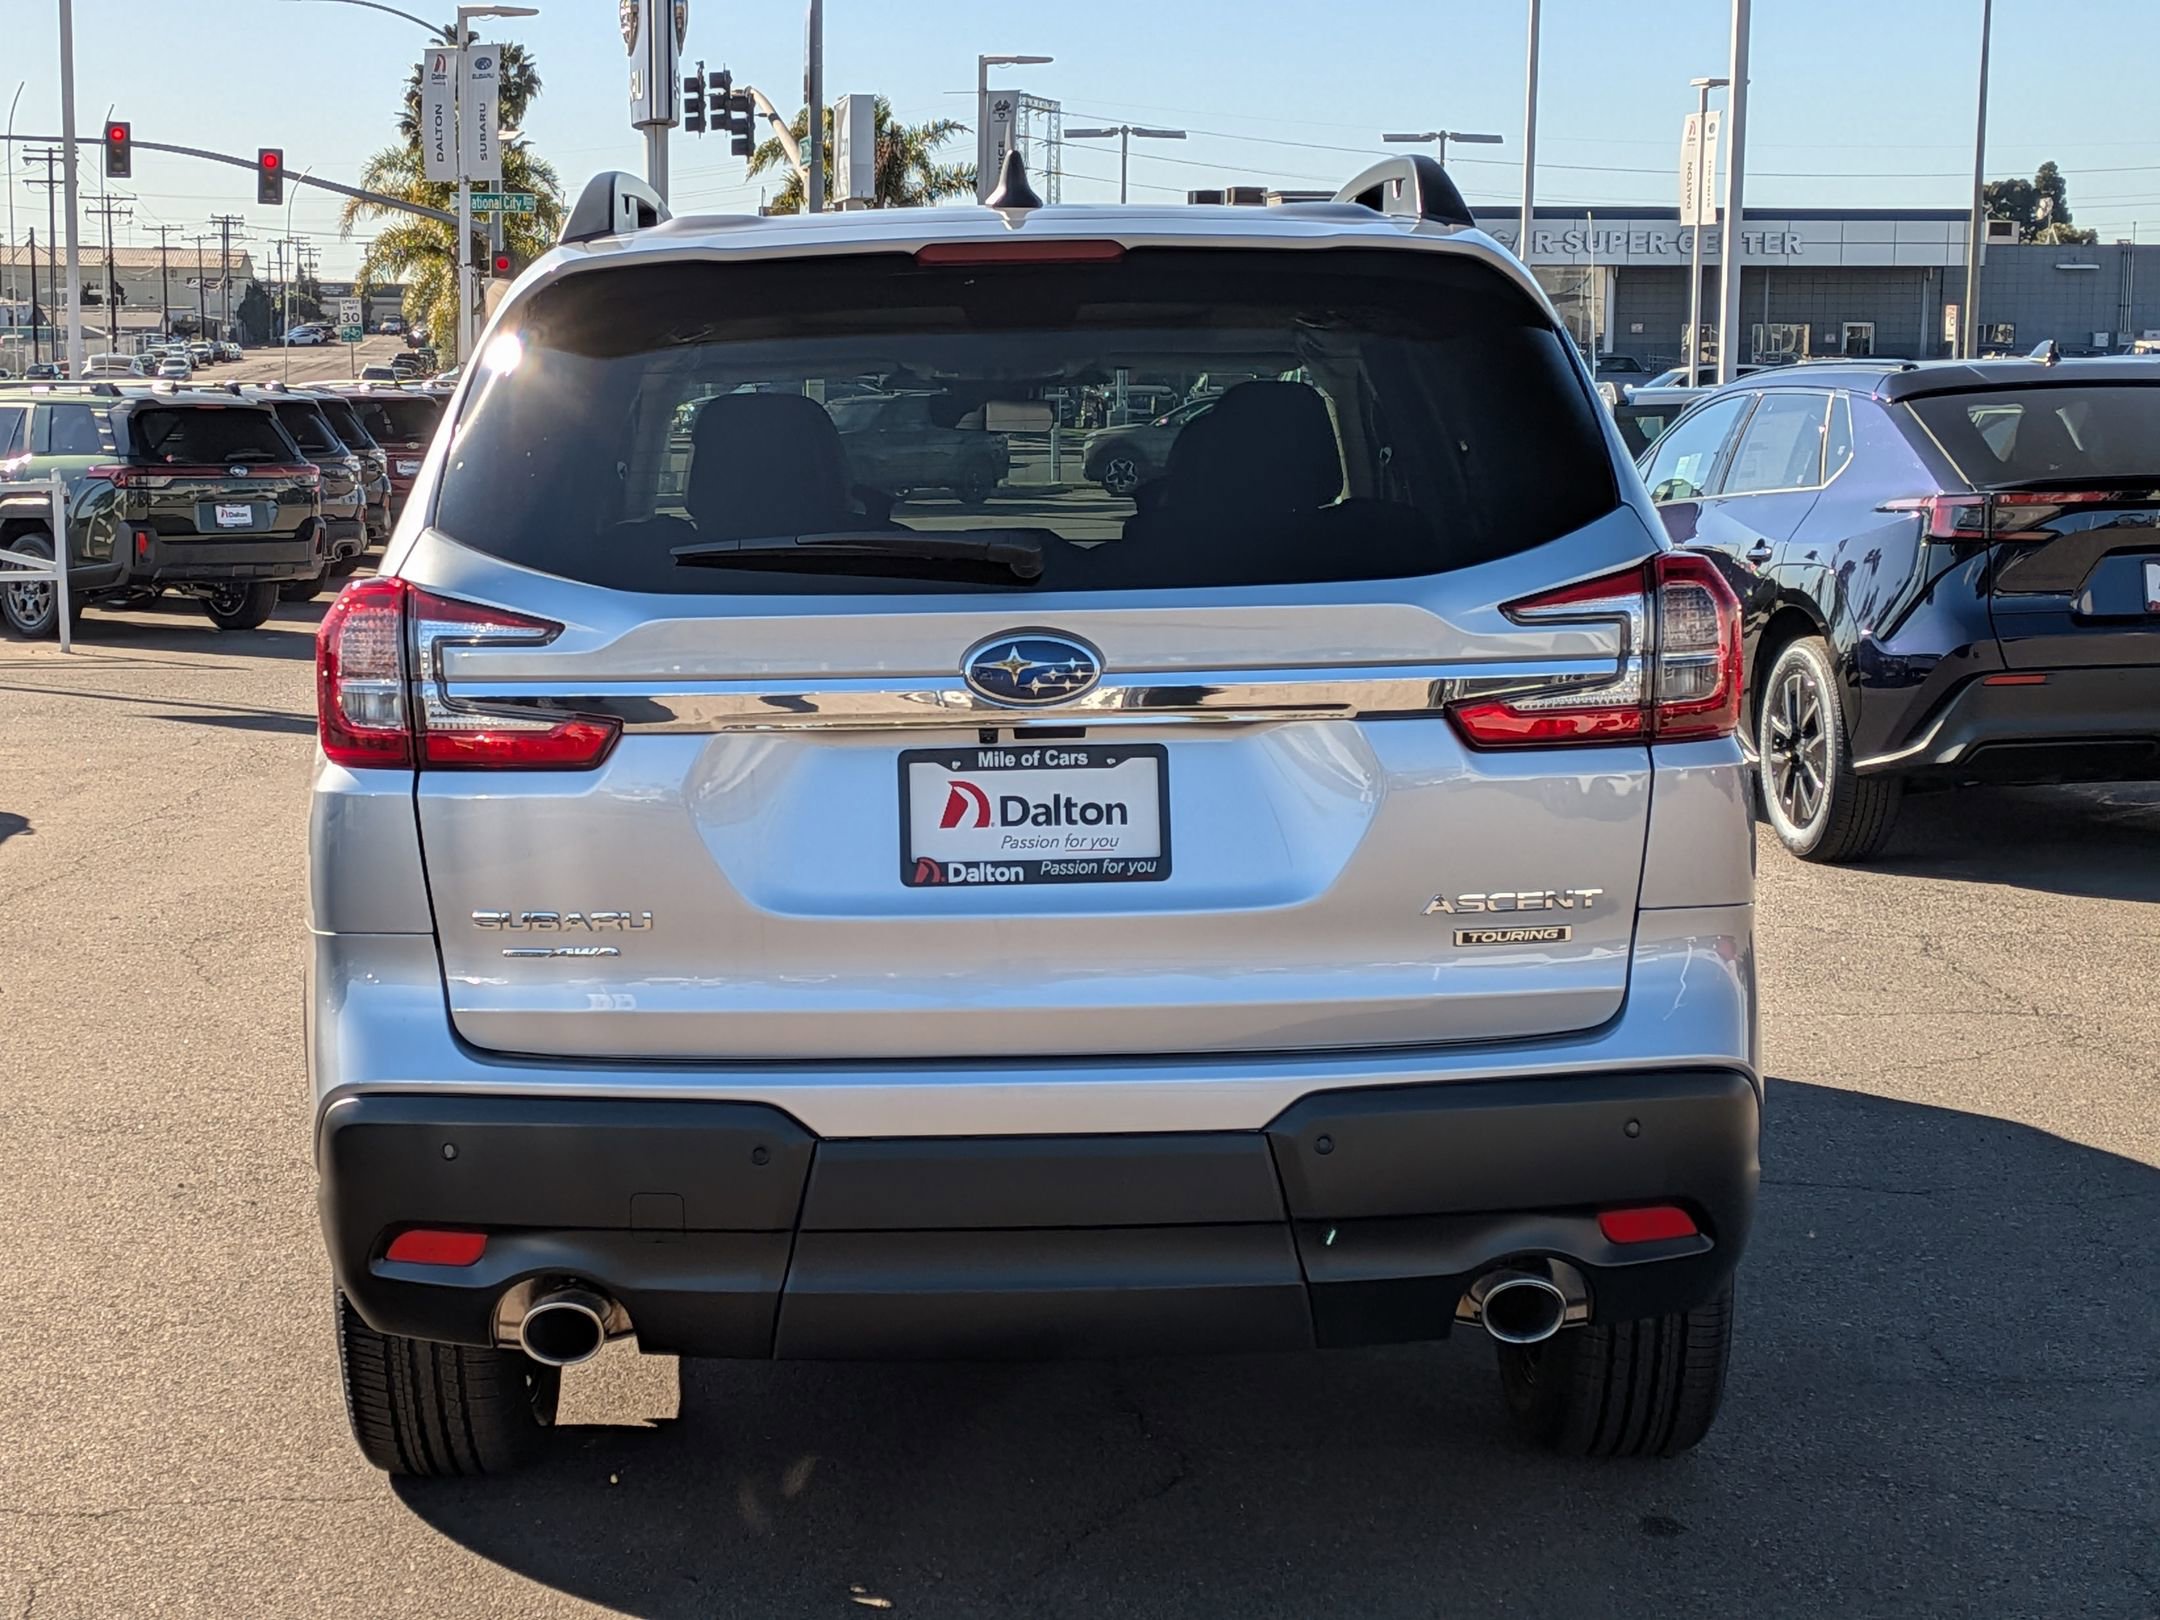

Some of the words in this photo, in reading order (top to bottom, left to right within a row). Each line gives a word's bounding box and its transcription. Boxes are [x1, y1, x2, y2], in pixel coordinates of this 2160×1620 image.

[434, 104, 445, 162] DALTON
[479, 103, 488, 161] SUBARU
[471, 195, 502, 209] ational
[503, 195, 522, 211] City
[1563, 230, 1669, 254] SUPER
[1677, 230, 1804, 254] CETER
[342, 312, 360, 323] 30
[978, 751, 1015, 768] Mile
[1021, 750, 1042, 767] of
[1045, 750, 1089, 766] Cars
[1000, 793, 1128, 827] Dalton
[1001, 835, 1060, 850] Passion
[1065, 833, 1087, 850] for
[1090, 836, 1120, 851] you
[948, 862, 1025, 883] Dalton
[1040, 860, 1101, 876] Passion
[1103, 859, 1125, 875] for
[1128, 861, 1157, 876] you
[1421, 888, 1604, 915] ASCENT
[471, 911, 654, 932] SUBARU
[1468, 928, 1560, 943] TOURING
